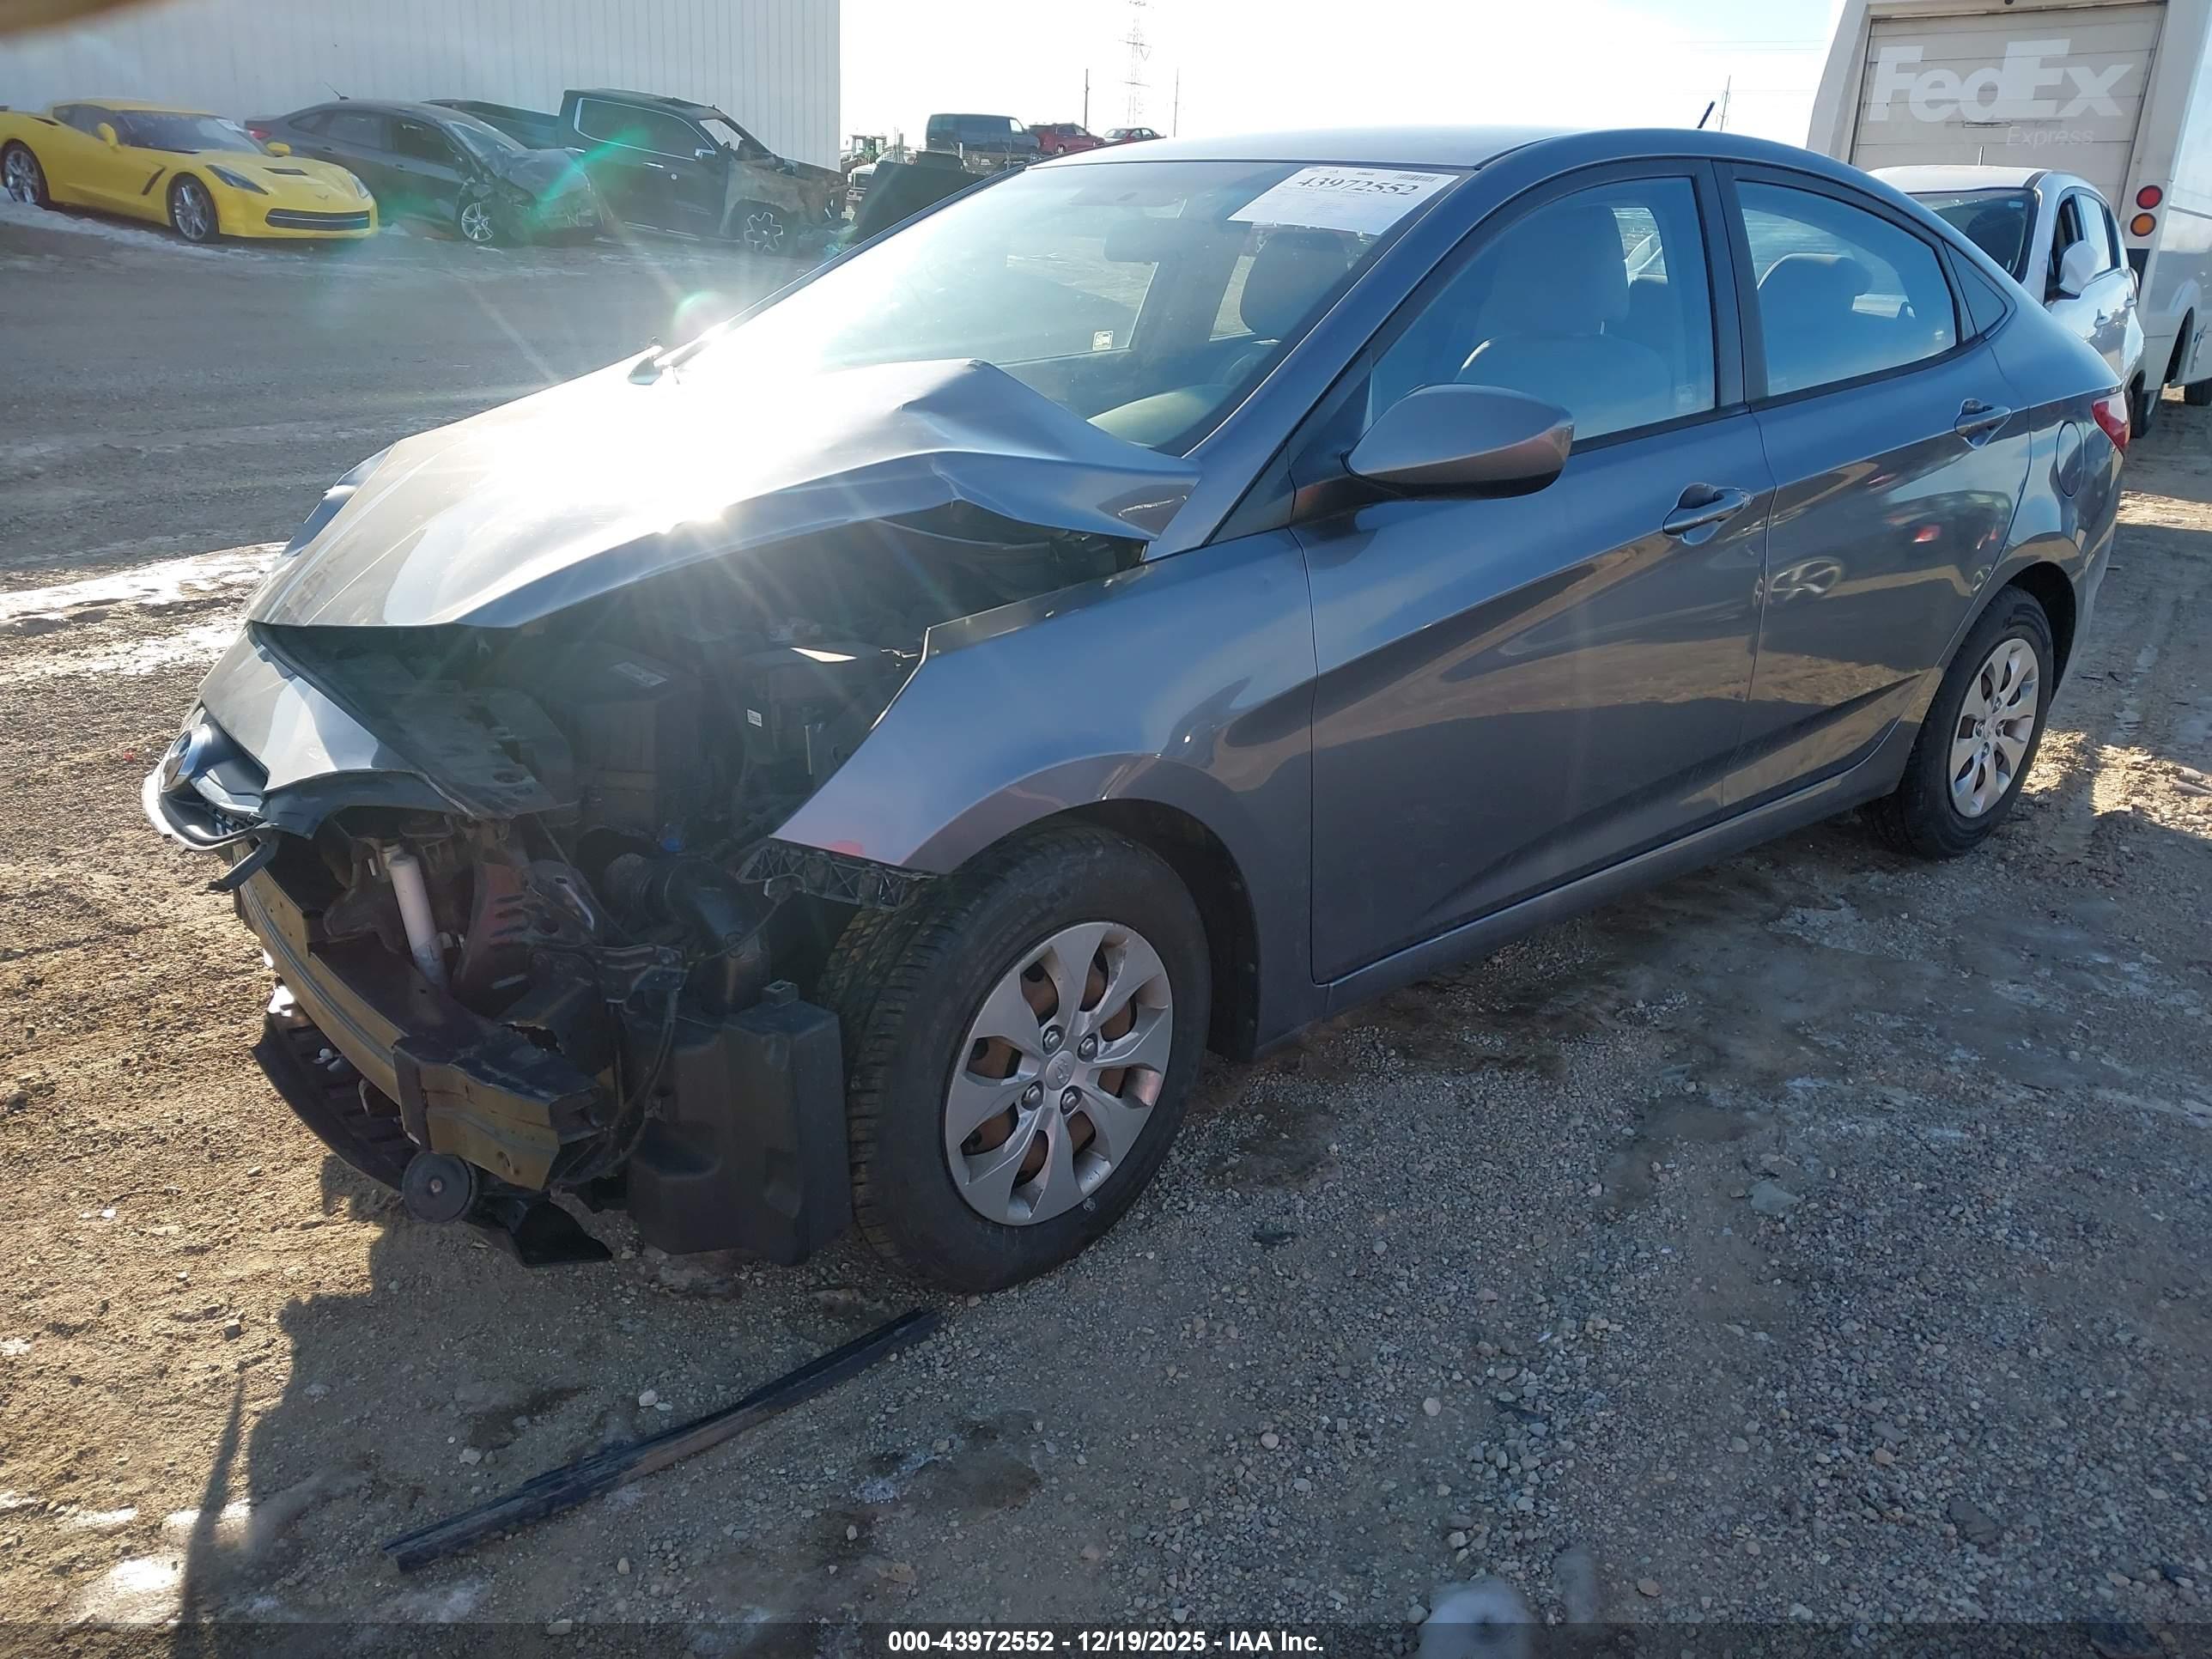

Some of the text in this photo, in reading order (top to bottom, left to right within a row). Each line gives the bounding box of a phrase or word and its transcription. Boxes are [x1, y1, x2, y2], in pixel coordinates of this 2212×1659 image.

[1869, 39, 2134, 123] FedEx
[2007, 126, 2094, 147] Express
[1297, 176, 1419, 196] 43972552
